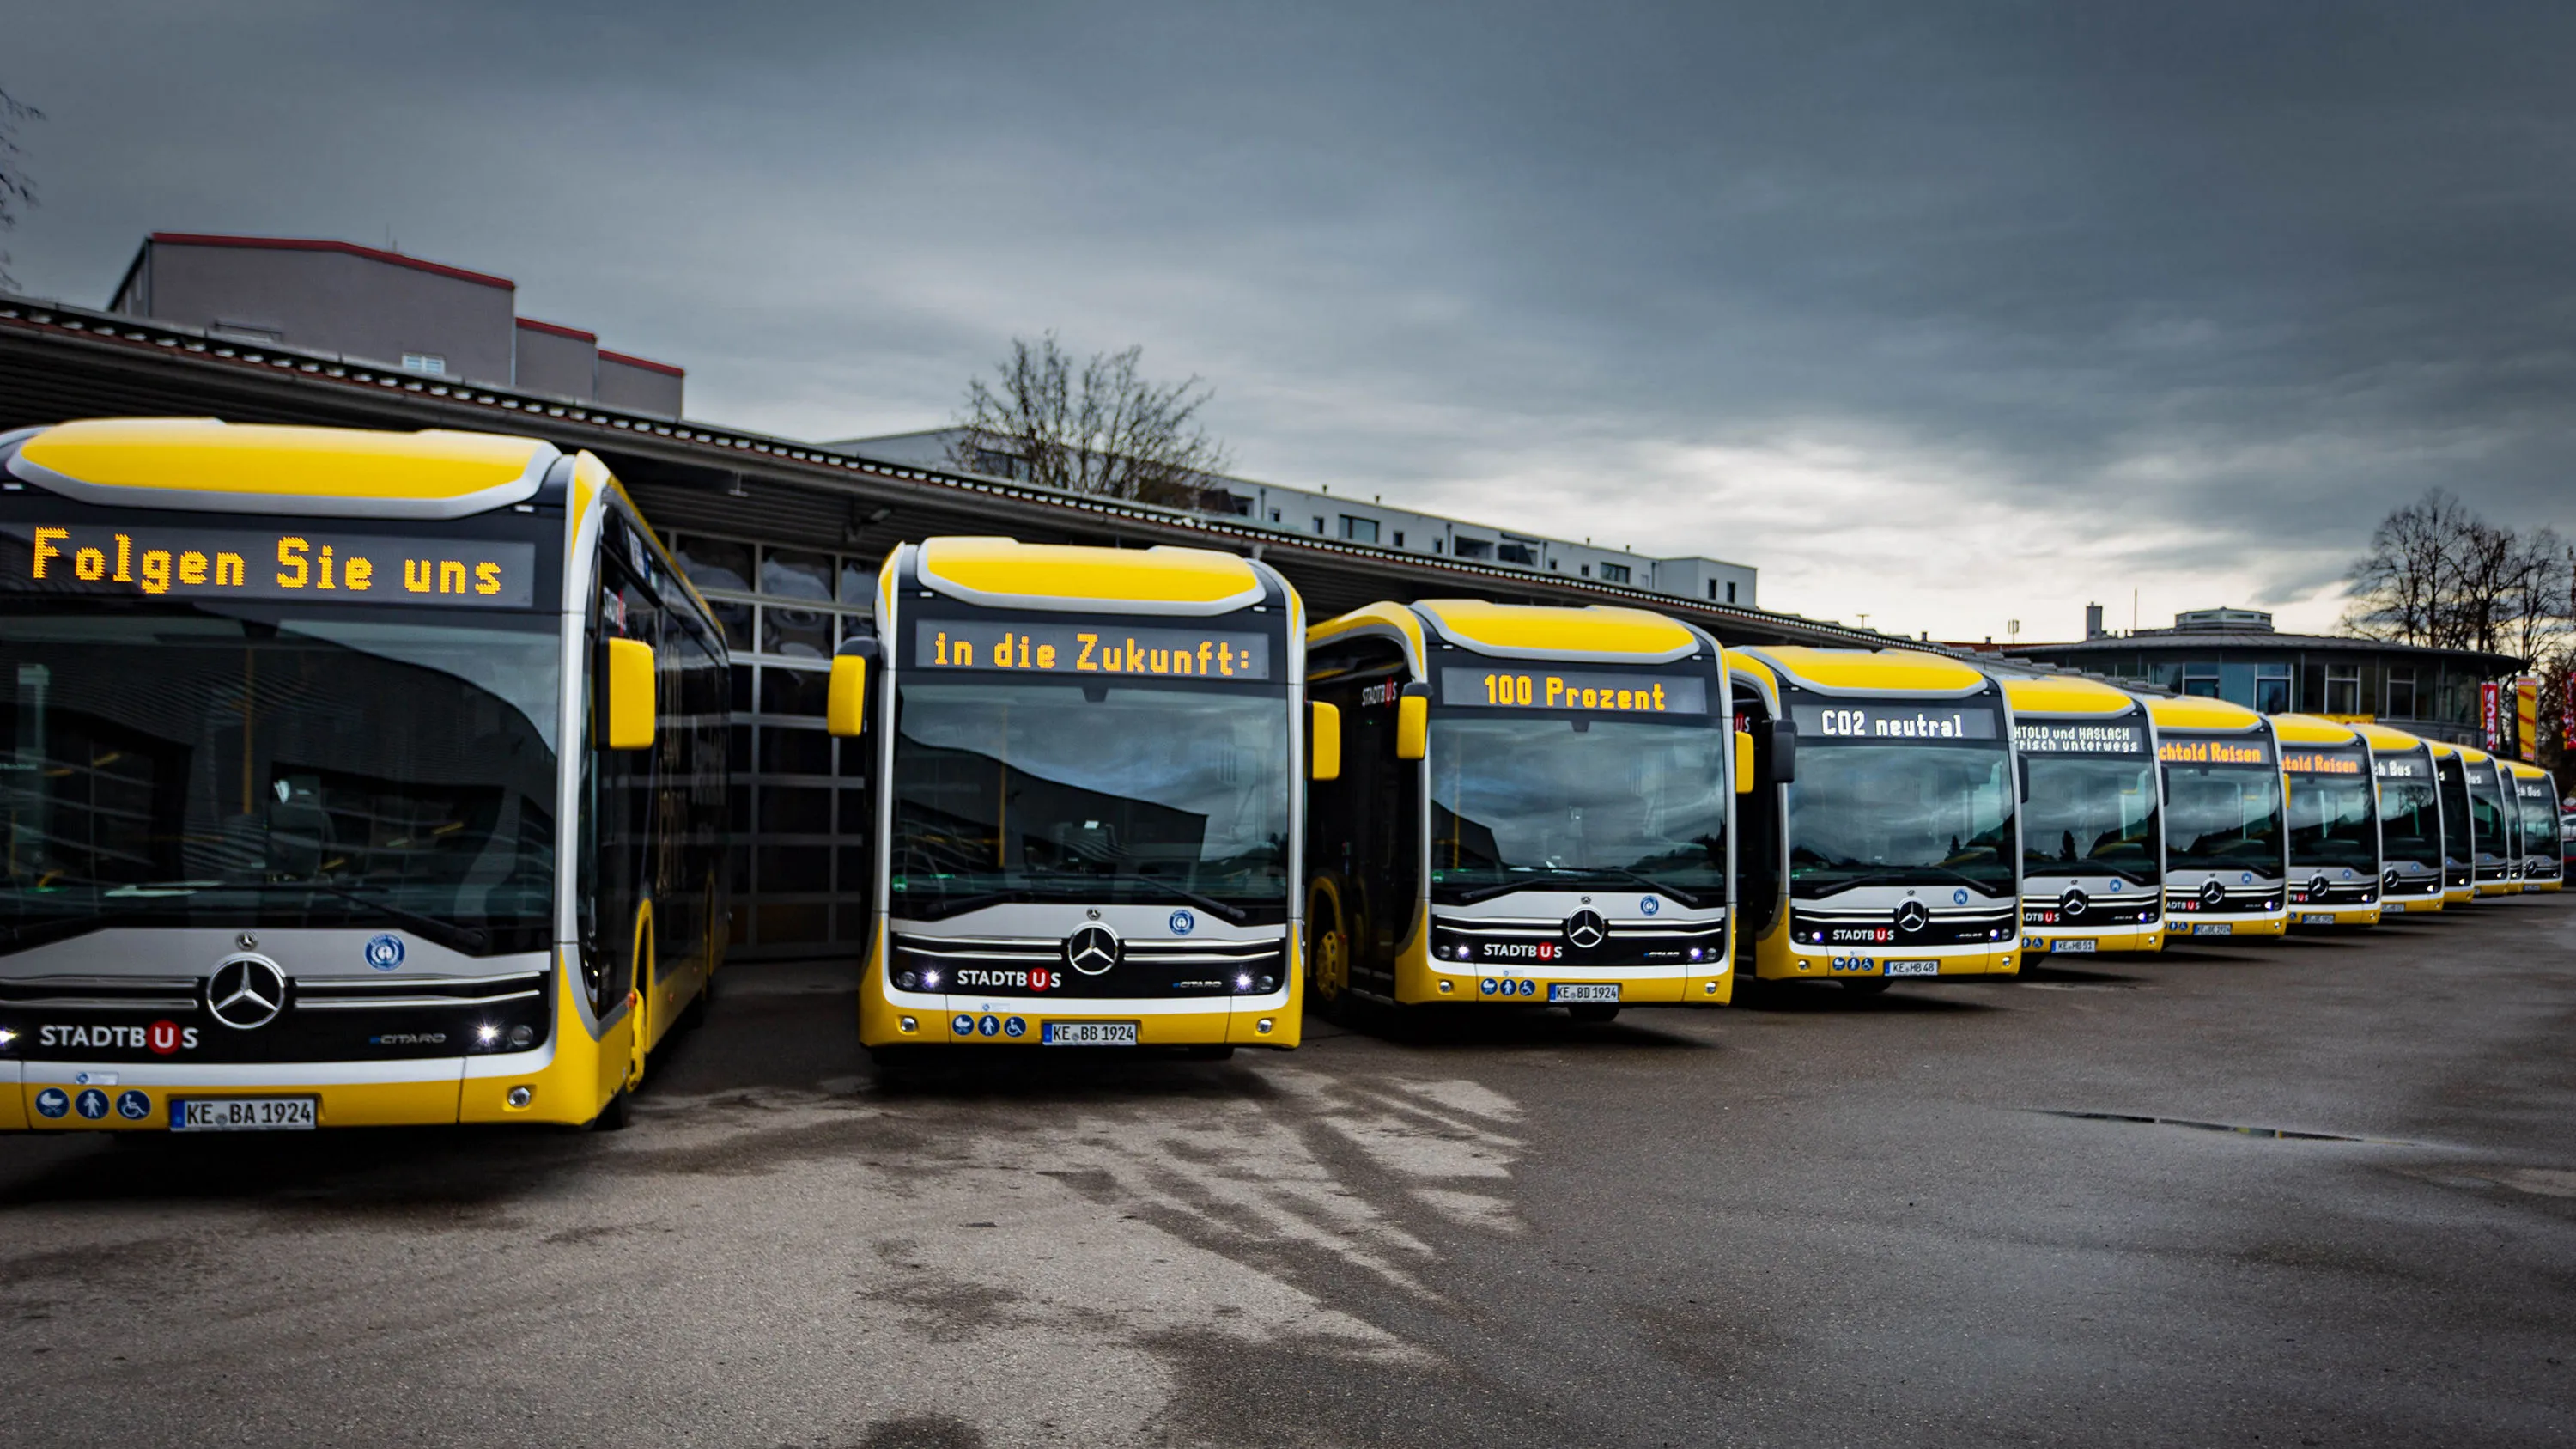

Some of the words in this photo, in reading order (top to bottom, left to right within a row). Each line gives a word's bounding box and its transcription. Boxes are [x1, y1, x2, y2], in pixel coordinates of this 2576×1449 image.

[33, 527, 245, 594] Folgen
[276, 537, 372, 589] Sie
[404, 558, 501, 594] uns
[934, 631, 973, 666] in
[993, 632, 1055, 669] die
[1076, 633, 1249, 676] Zukunft:
[1484, 674, 1532, 706] 100
[1546, 677, 1666, 711] Prozent
[1821, 709, 1866, 736] CO2
[1875, 713, 1964, 737] neutral
[2052, 727, 2075, 740] und
[2078, 727, 2130, 740] HASLACH
[2014, 738, 2057, 751] risch
[2062, 740, 2138, 752] unterwegs
[2389, 760, 2411, 776] Bus
[1832, 929, 1894, 941] STADTBUS
[1483, 943, 1563, 959] STADTBUS
[1893, 963, 1904, 972] KE
[957, 969, 1061, 988] STADTBUS
[1557, 987, 1569, 999] KE
[1592, 986, 1617, 999] 1924
[39, 1025, 199, 1049] STADTBUS
[1053, 1026, 1070, 1041] KE
[1081, 1026, 1097, 1041] BB
[1102, 1026, 1133, 1041] 1924
[186, 1103, 214, 1124] KE
[229, 1103, 257, 1124] BA
[261, 1102, 311, 1124] 1924
